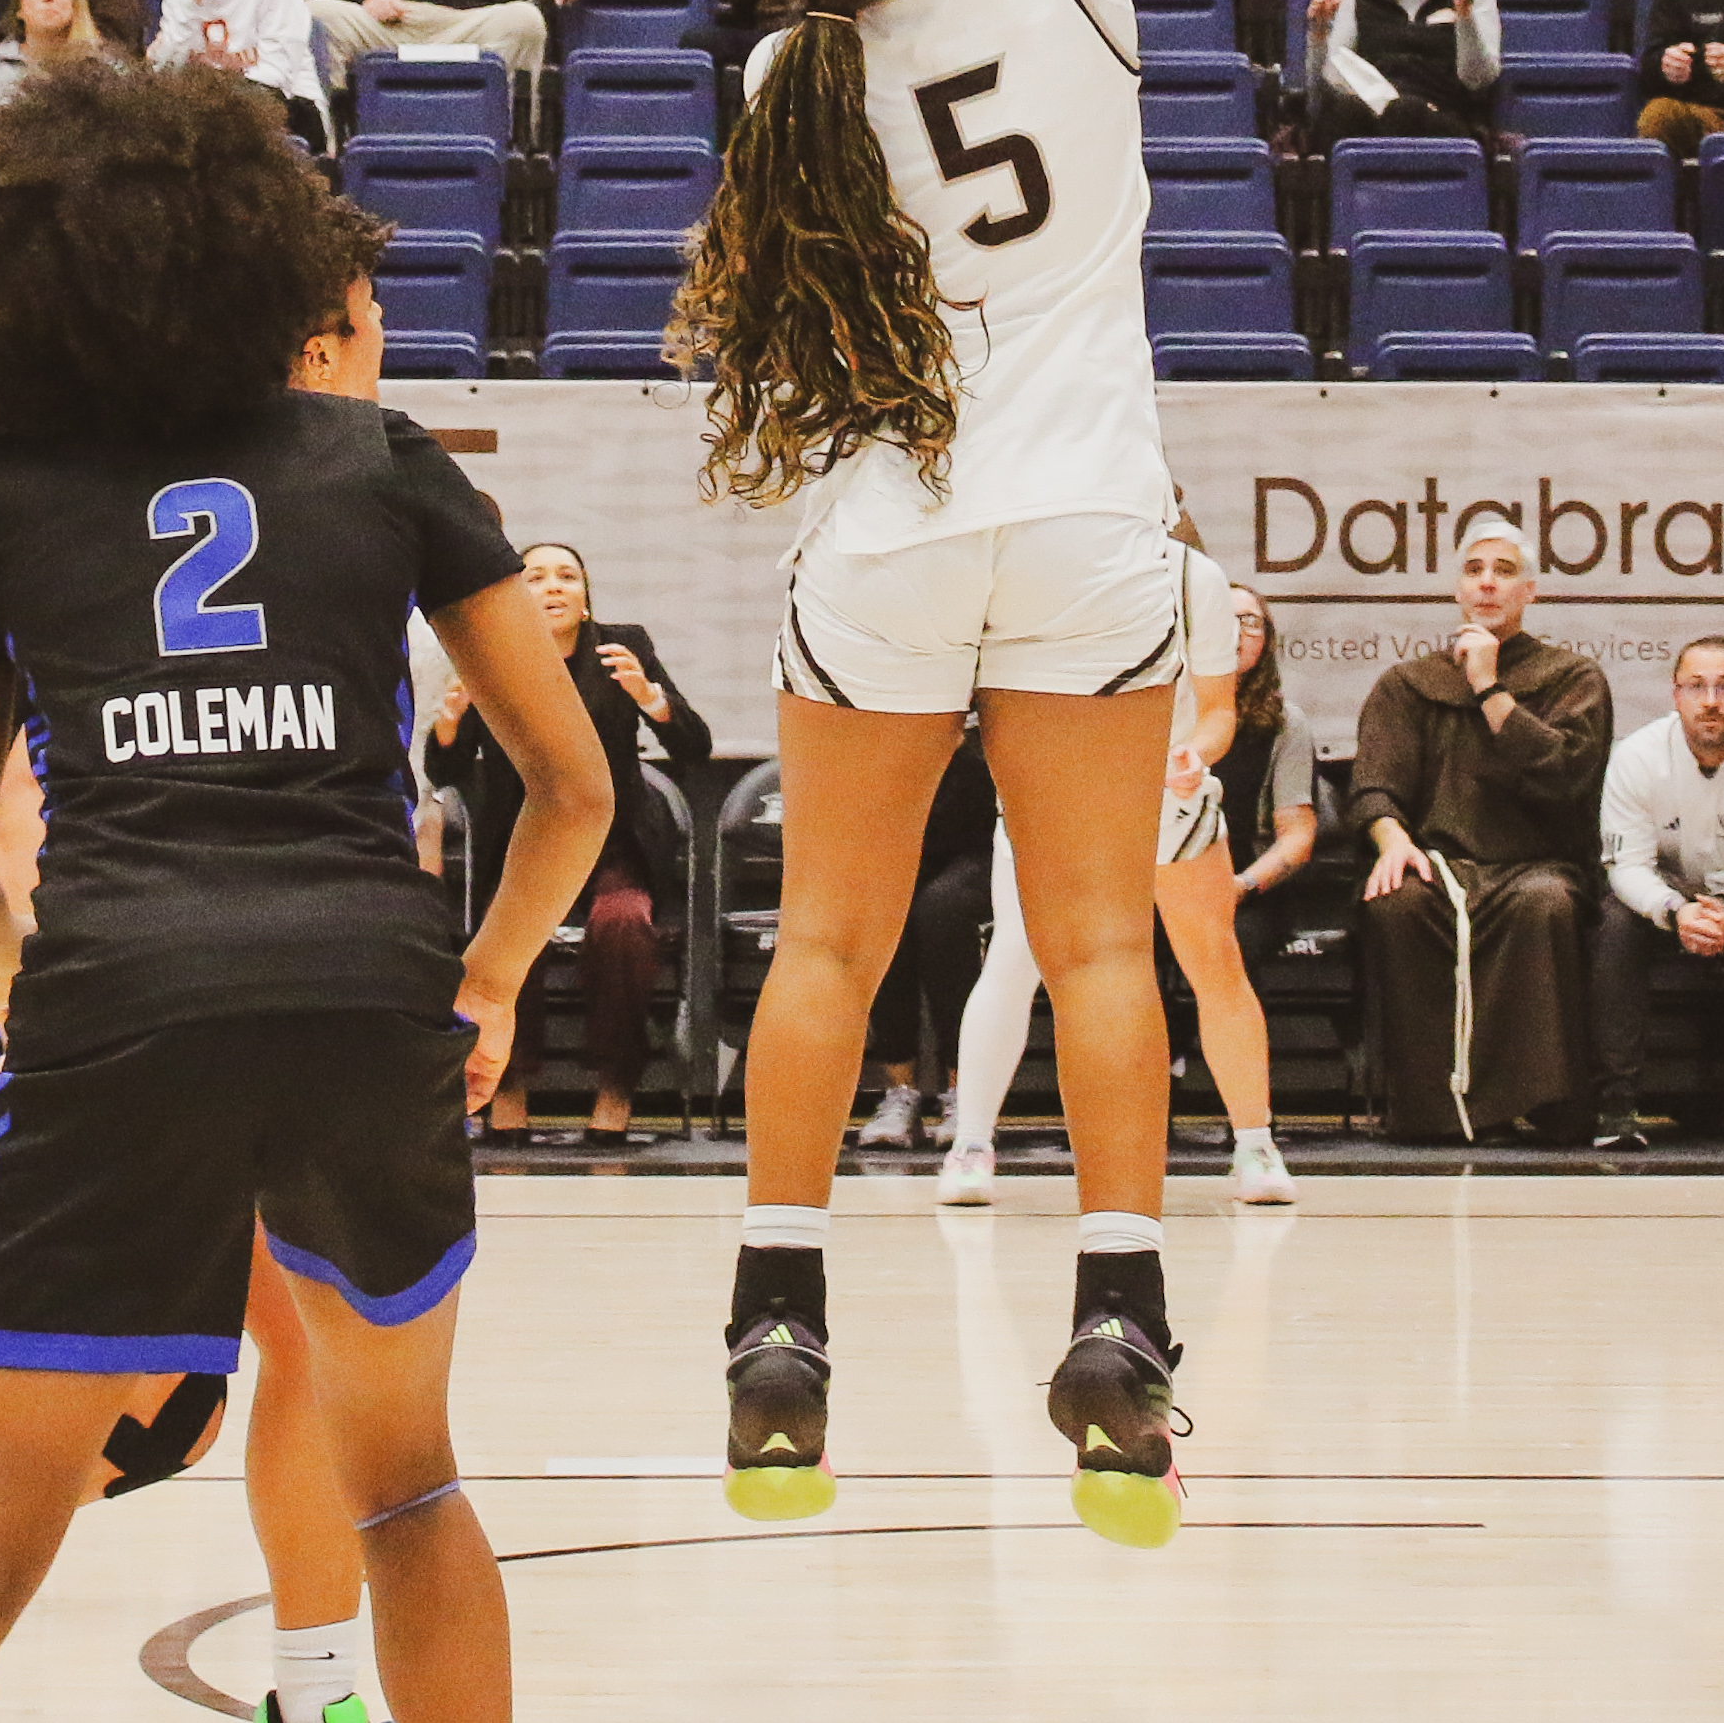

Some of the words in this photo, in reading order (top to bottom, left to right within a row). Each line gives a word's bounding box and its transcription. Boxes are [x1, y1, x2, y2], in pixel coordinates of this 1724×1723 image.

[909, 51, 1055, 252] 5
[146, 477, 268, 658] 2
[1539, 633, 1673, 663] rvices
[101, 684, 337, 764] COLEMAN
